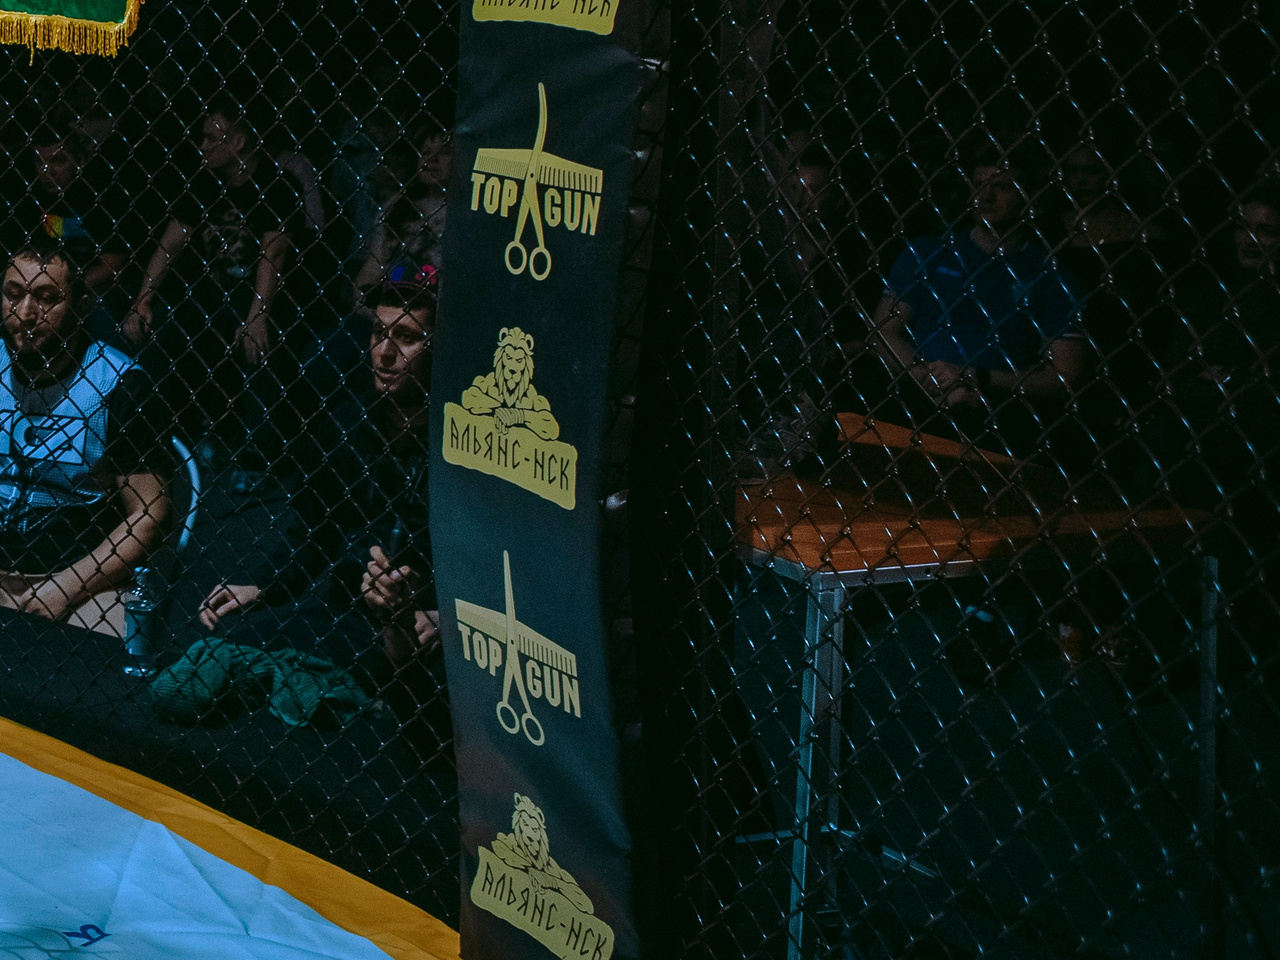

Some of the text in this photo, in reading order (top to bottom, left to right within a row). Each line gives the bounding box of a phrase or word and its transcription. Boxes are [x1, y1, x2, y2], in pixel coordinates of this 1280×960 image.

[471, 172, 601, 236] TOP GUN
[457, 622, 581, 718] TOP GUN
